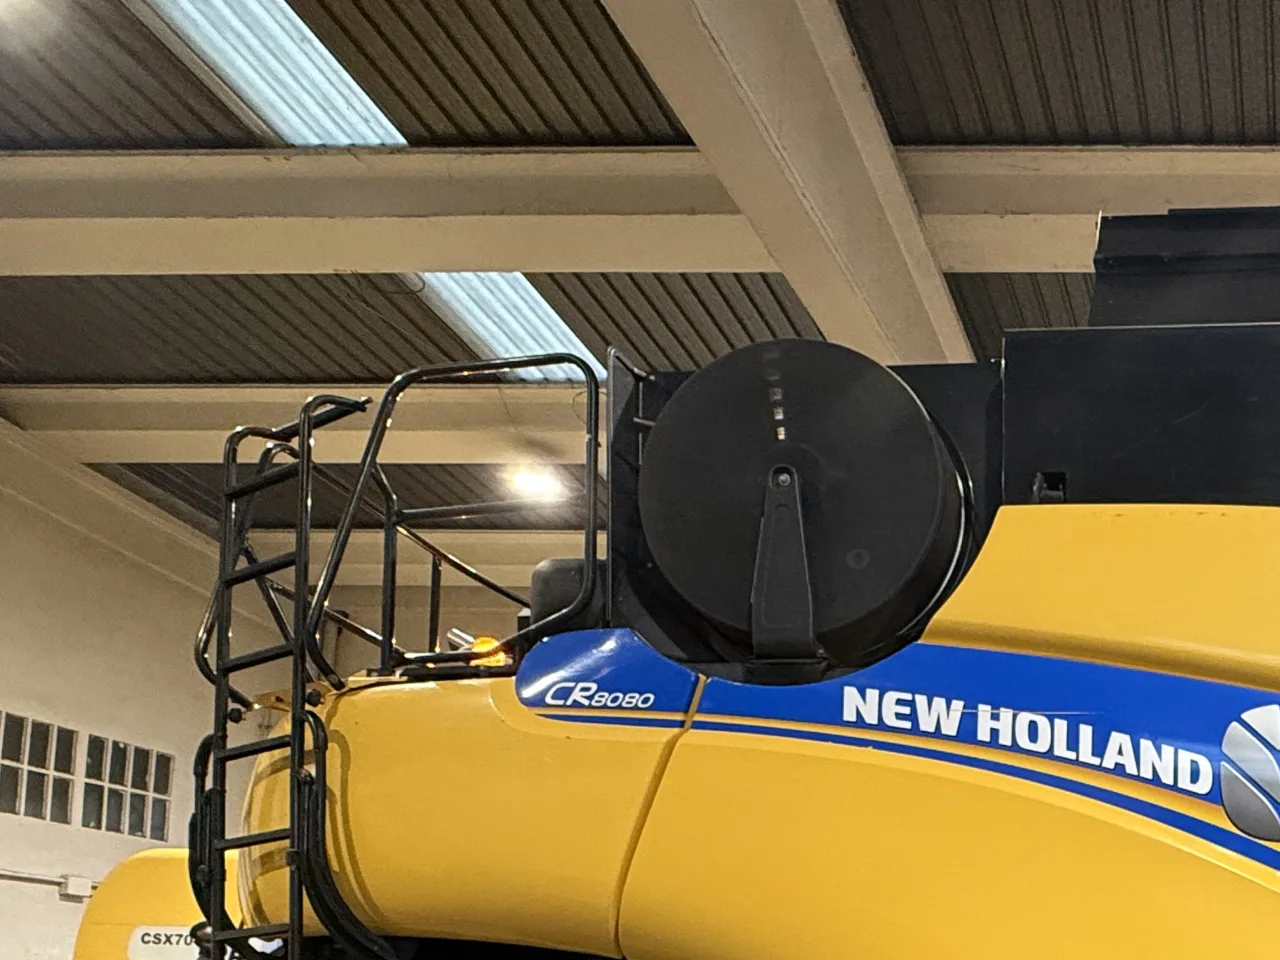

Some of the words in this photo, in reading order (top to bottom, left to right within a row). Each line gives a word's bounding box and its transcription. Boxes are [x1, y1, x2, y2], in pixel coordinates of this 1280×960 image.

[544, 682, 655, 708] CR8080
[842, 686, 964, 737] NEW
[977, 704, 1213, 795] HOLLAND
[141, 932, 195, 946] CSX70
